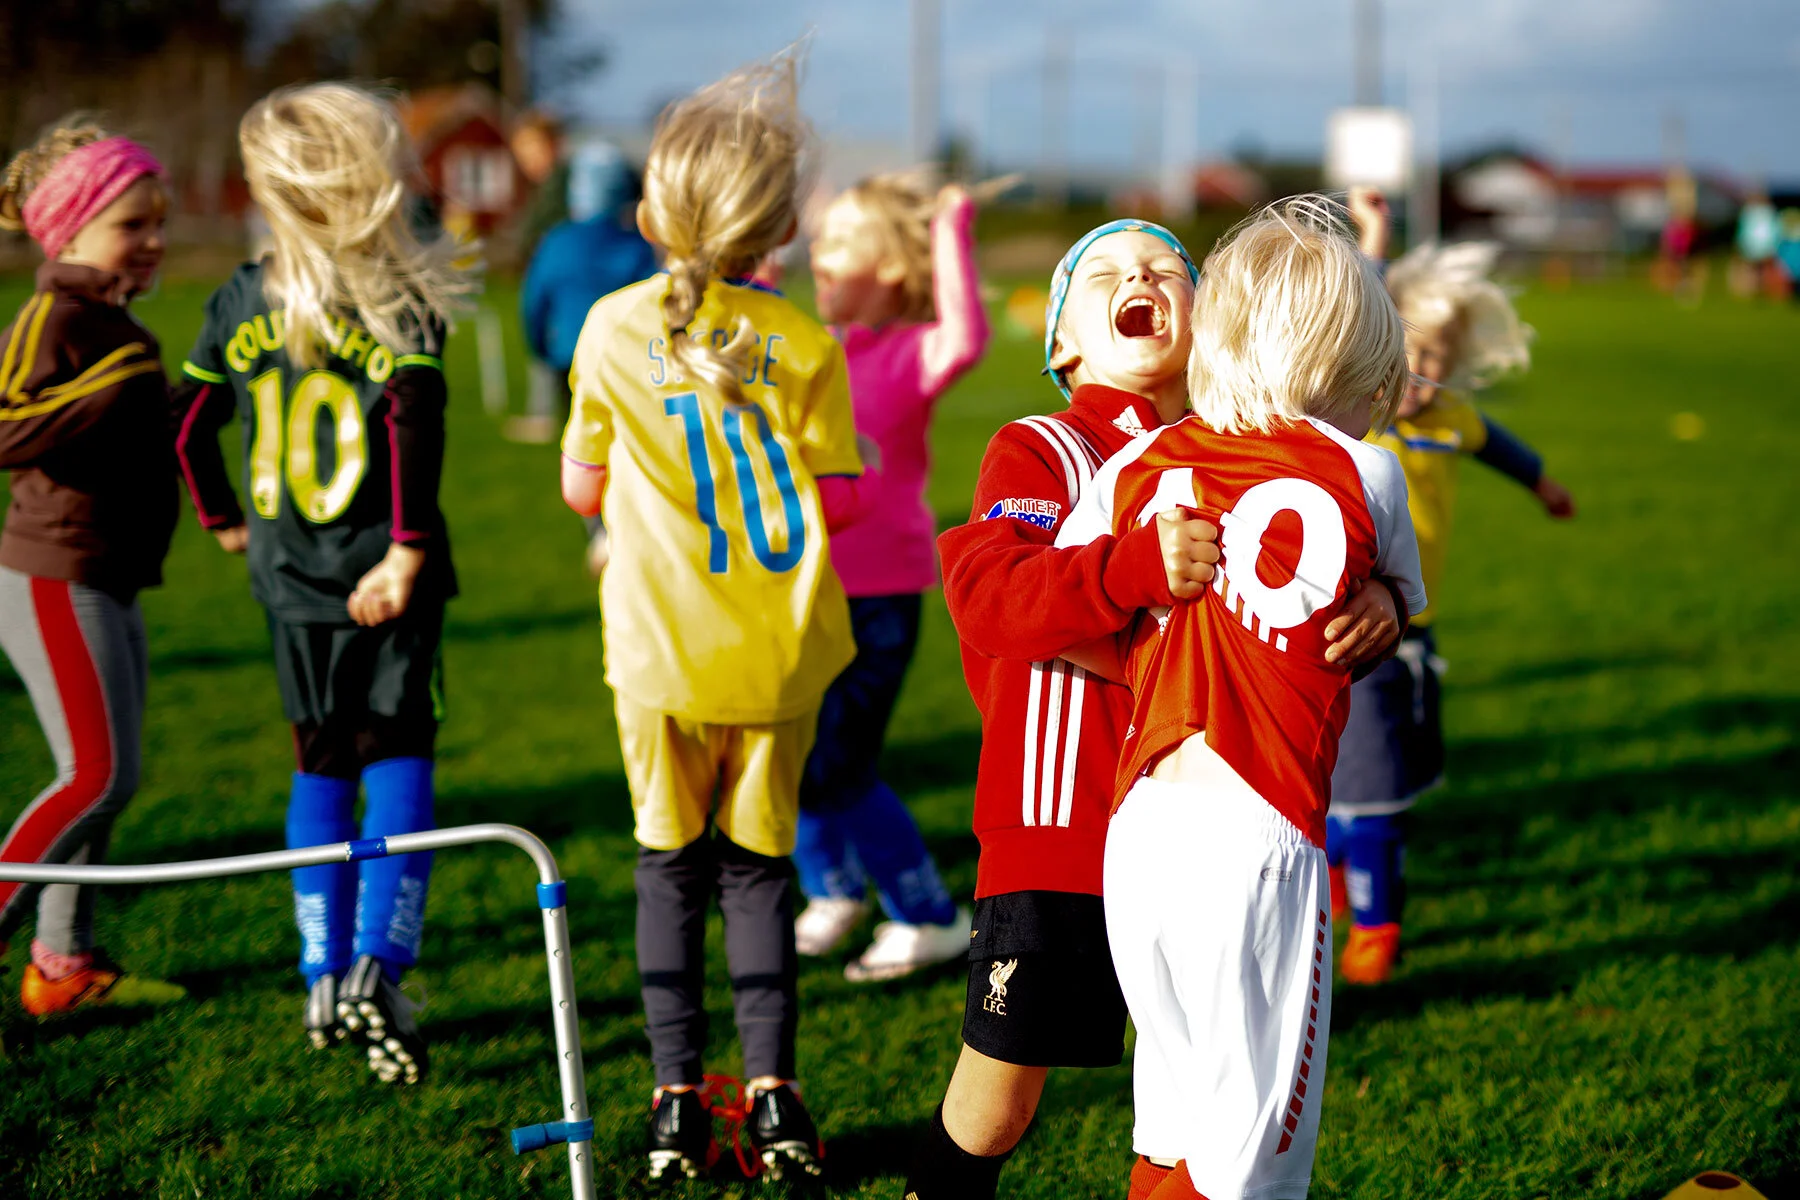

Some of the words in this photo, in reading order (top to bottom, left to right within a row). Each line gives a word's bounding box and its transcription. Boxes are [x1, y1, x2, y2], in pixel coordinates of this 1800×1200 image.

[247, 367, 367, 524] 10
[663, 393, 805, 574] 10
[1004, 498, 1058, 517] INTER
